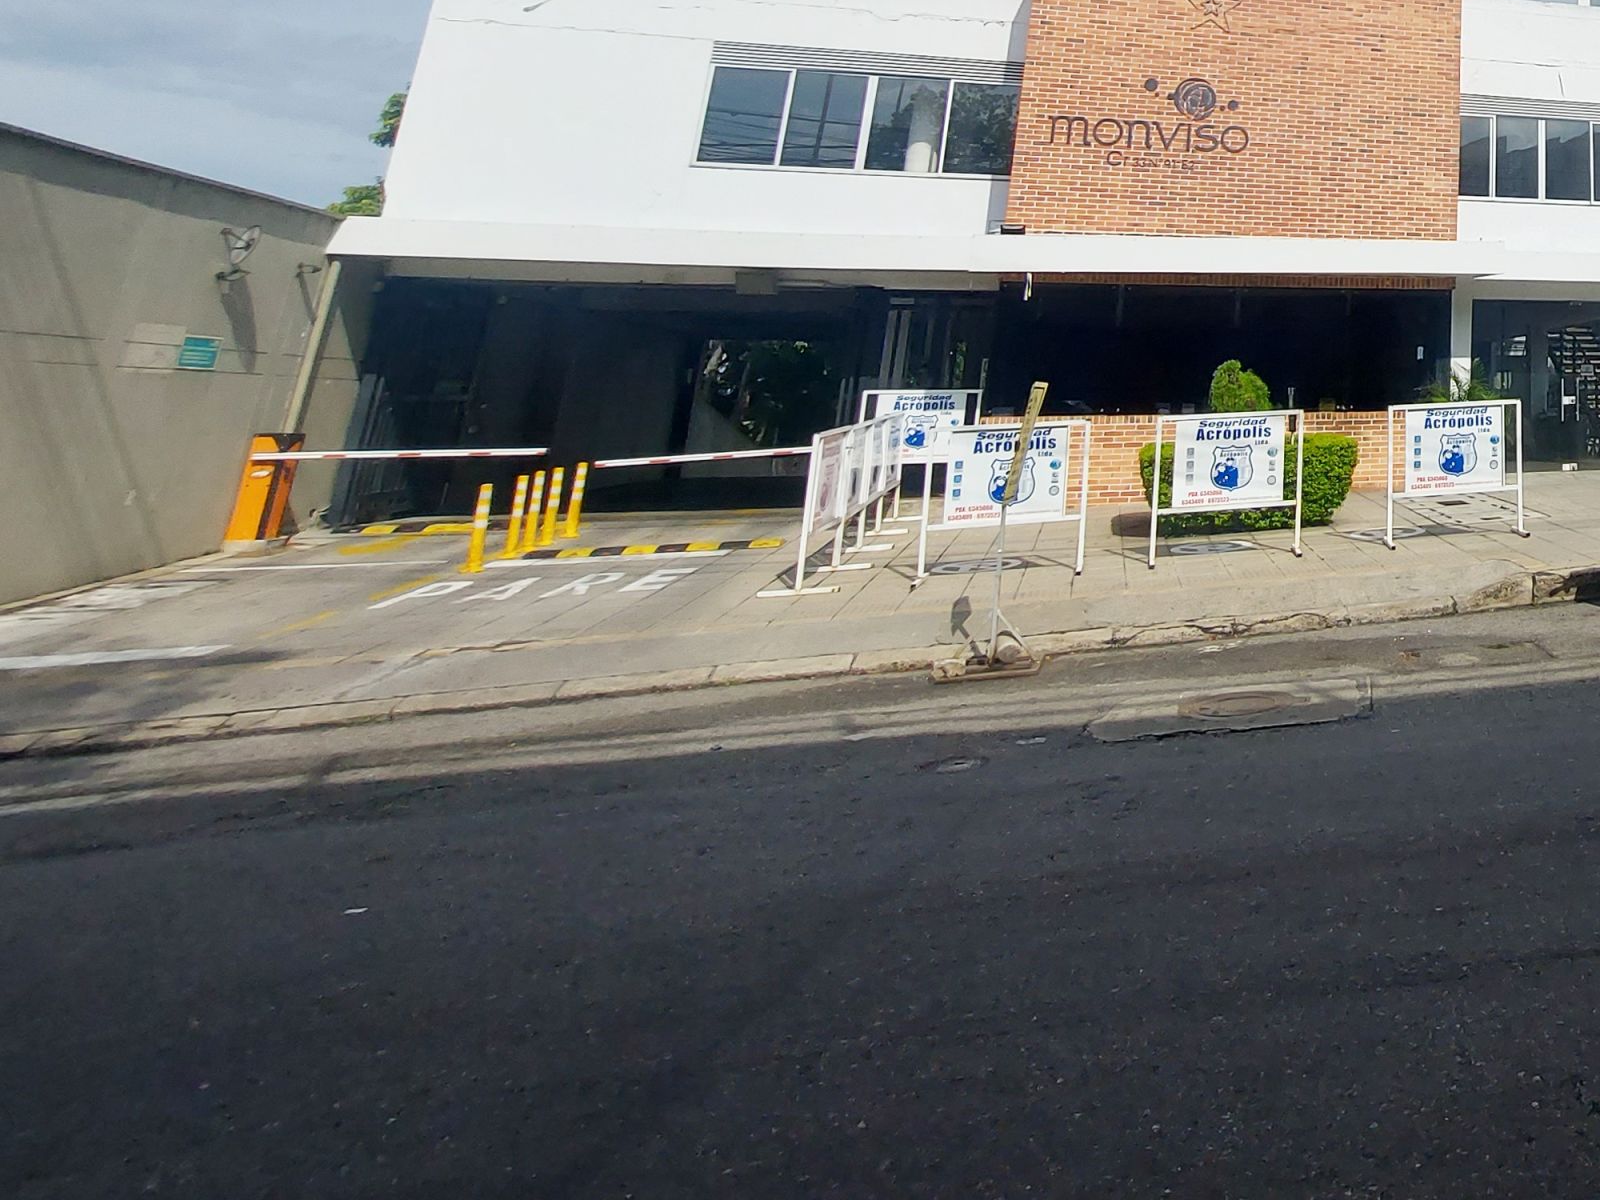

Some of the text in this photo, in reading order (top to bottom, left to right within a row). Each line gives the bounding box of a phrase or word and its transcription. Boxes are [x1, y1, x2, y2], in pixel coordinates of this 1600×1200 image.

[1048, 115, 1249, 153] monviso
[1426, 406, 1488, 417] Seguridad
[1199, 418, 1267, 428] Seguridad
[1424, 414, 1493, 429] Acrópolis
[977, 428, 1052, 440] Segurad
[1196, 426, 1272, 441] Acrópolis
[367, 567, 700, 610] PARE
